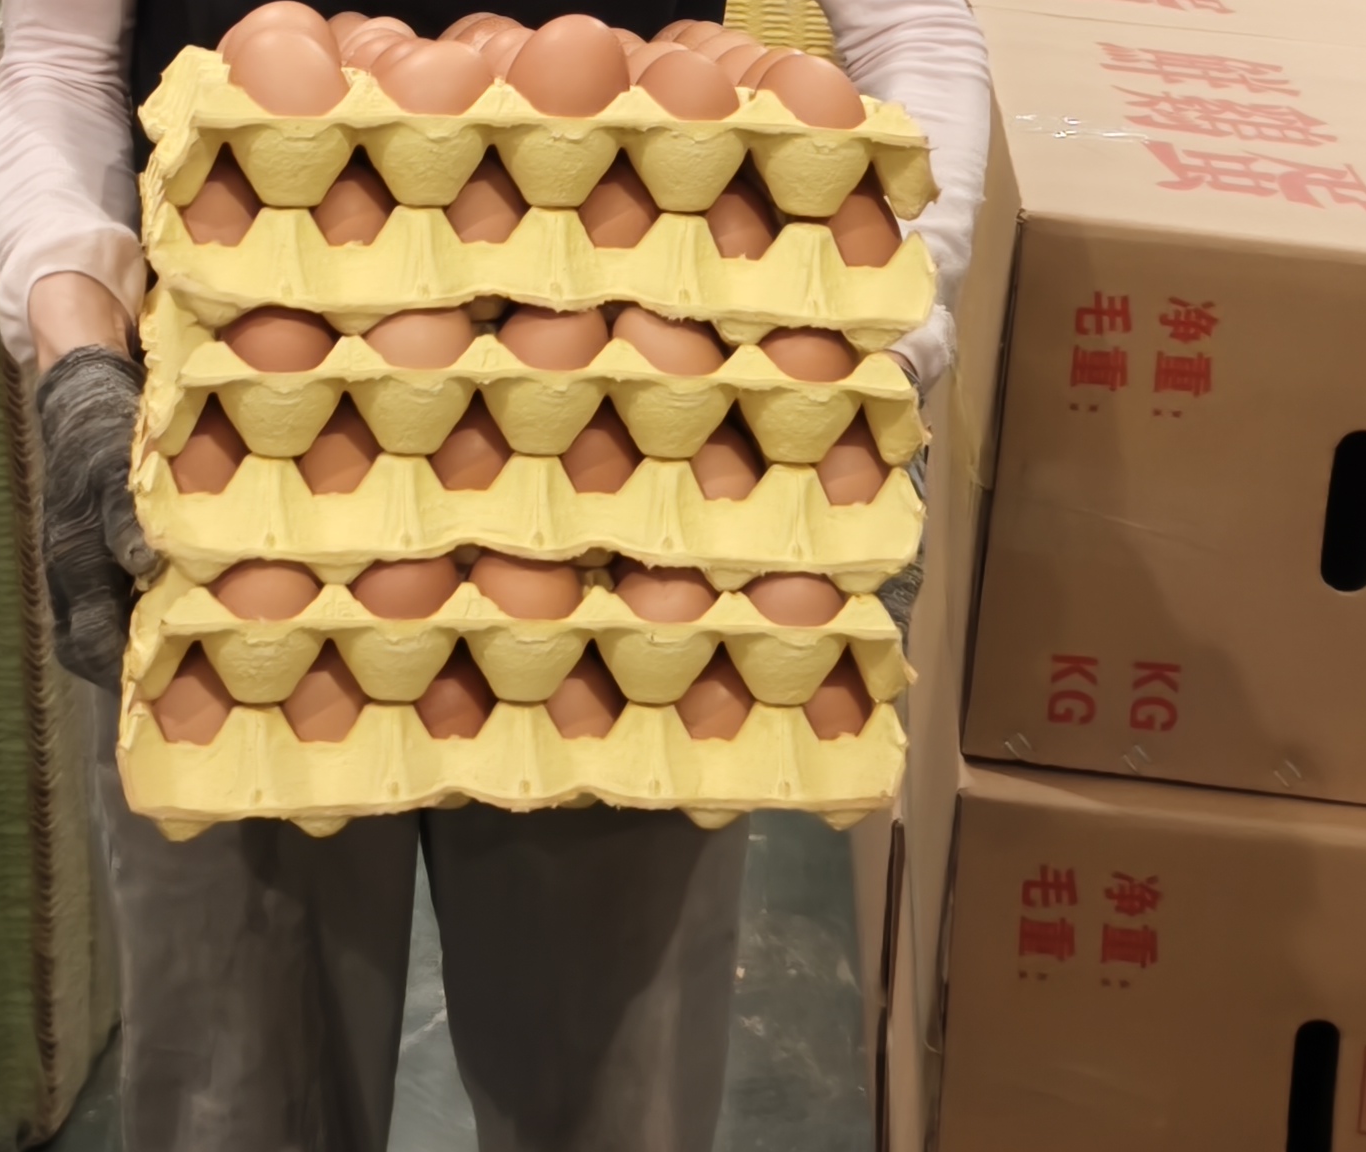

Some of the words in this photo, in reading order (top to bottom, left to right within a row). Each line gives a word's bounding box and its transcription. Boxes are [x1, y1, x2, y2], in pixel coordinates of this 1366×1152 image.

[1069, 291, 1133, 413] 毛重：
[1047, 654, 1099, 726] KG
[1129, 660, 1182, 733] KG
